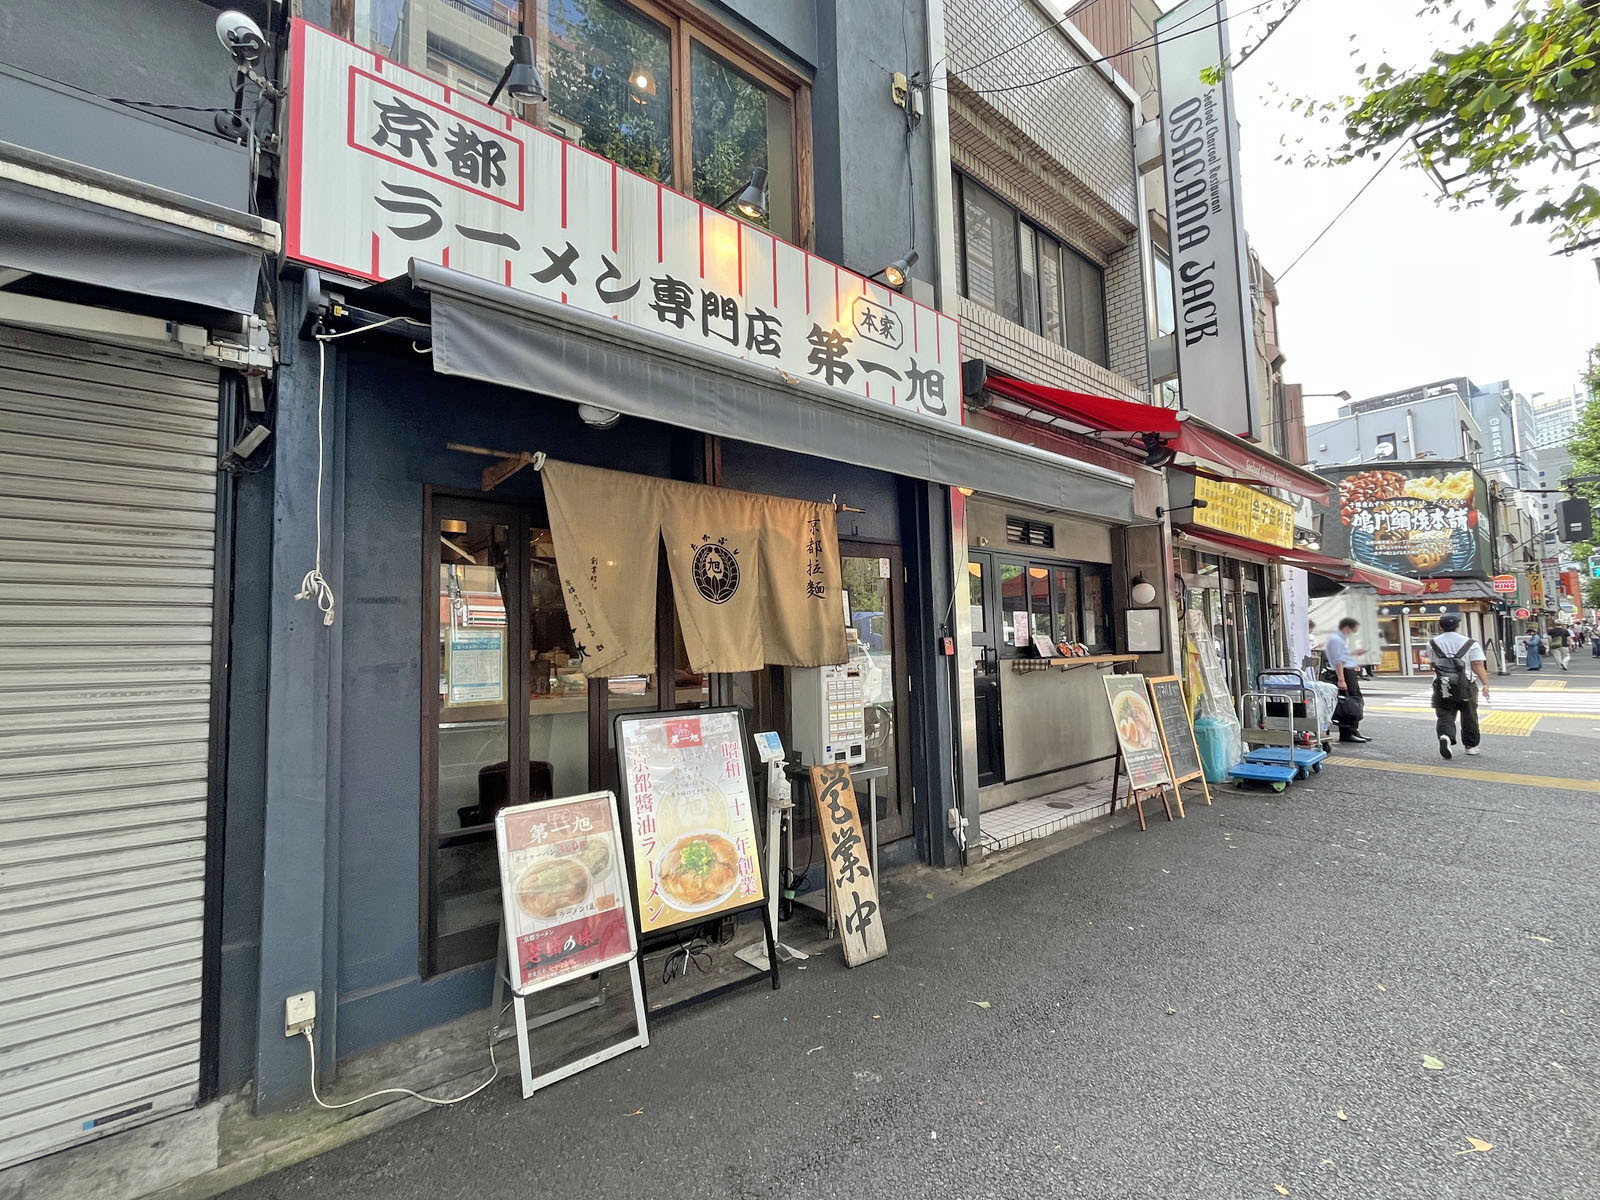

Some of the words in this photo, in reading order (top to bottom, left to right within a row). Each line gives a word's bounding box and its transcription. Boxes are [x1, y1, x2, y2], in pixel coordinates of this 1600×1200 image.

[1204, 88, 1216, 127] Seafood
[371, 96, 507, 188] 京都
[1206, 126, 1217, 166] Charcoal
[1208, 165, 1222, 215] Restaurant
[374, 180, 783, 359] ラーメン専門店
[807, 322, 948, 416] 第一旭
[860, 307, 897, 342] 本家
[1351, 507, 1468, 533] 鳴門鯛焼本舗
[707, 557, 723, 574] 旭
[529, 816, 593, 844] 第一旭
[720, 741, 757, 898] 昭和二十二年創業
[820, 768, 878, 953] 営業中
